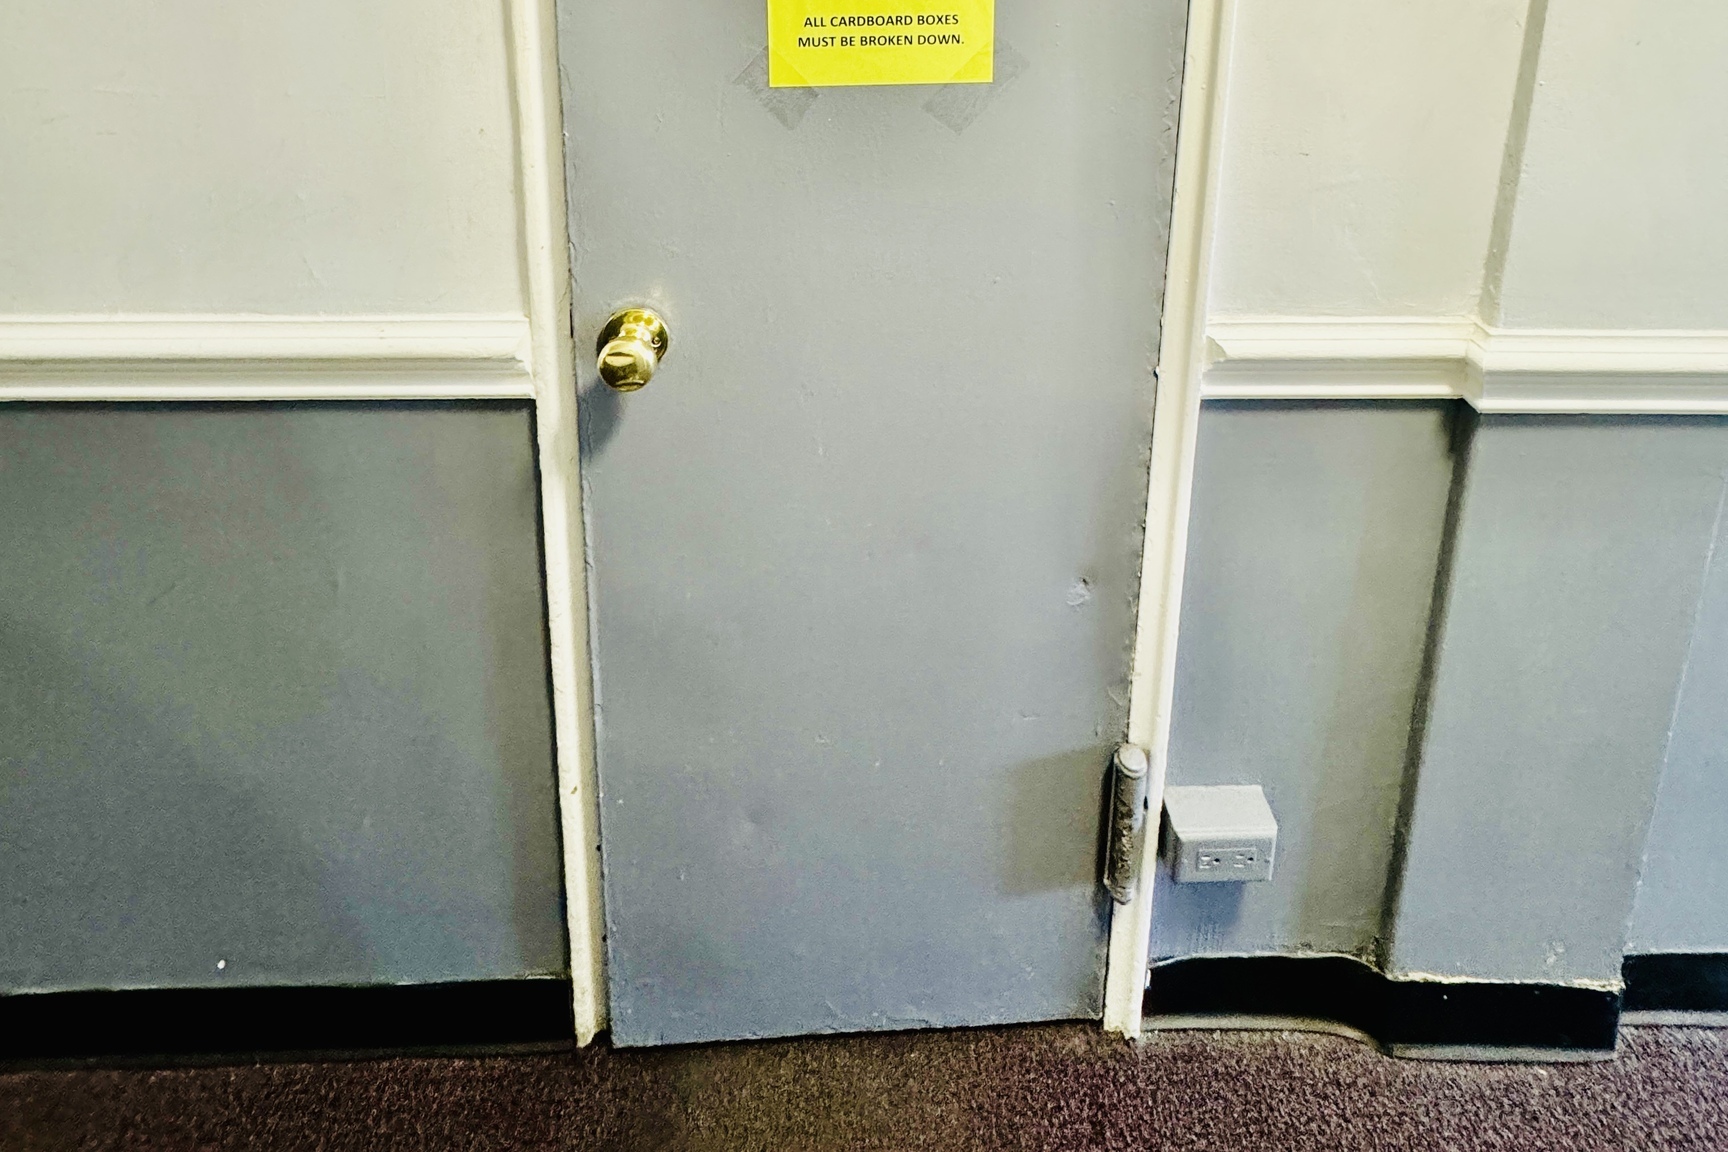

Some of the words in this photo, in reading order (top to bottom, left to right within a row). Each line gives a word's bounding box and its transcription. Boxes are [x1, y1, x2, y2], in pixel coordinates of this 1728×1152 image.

[803, 17, 827, 28] ALL
[830, 15, 913, 27] CARDBOARD
[917, 14, 959, 26] BOXES
[798, 36, 837, 48] MUST
[840, 36, 856, 47] BE
[860, 35, 913, 47] BROKEN
[917, 34, 964, 45] DOWN.
